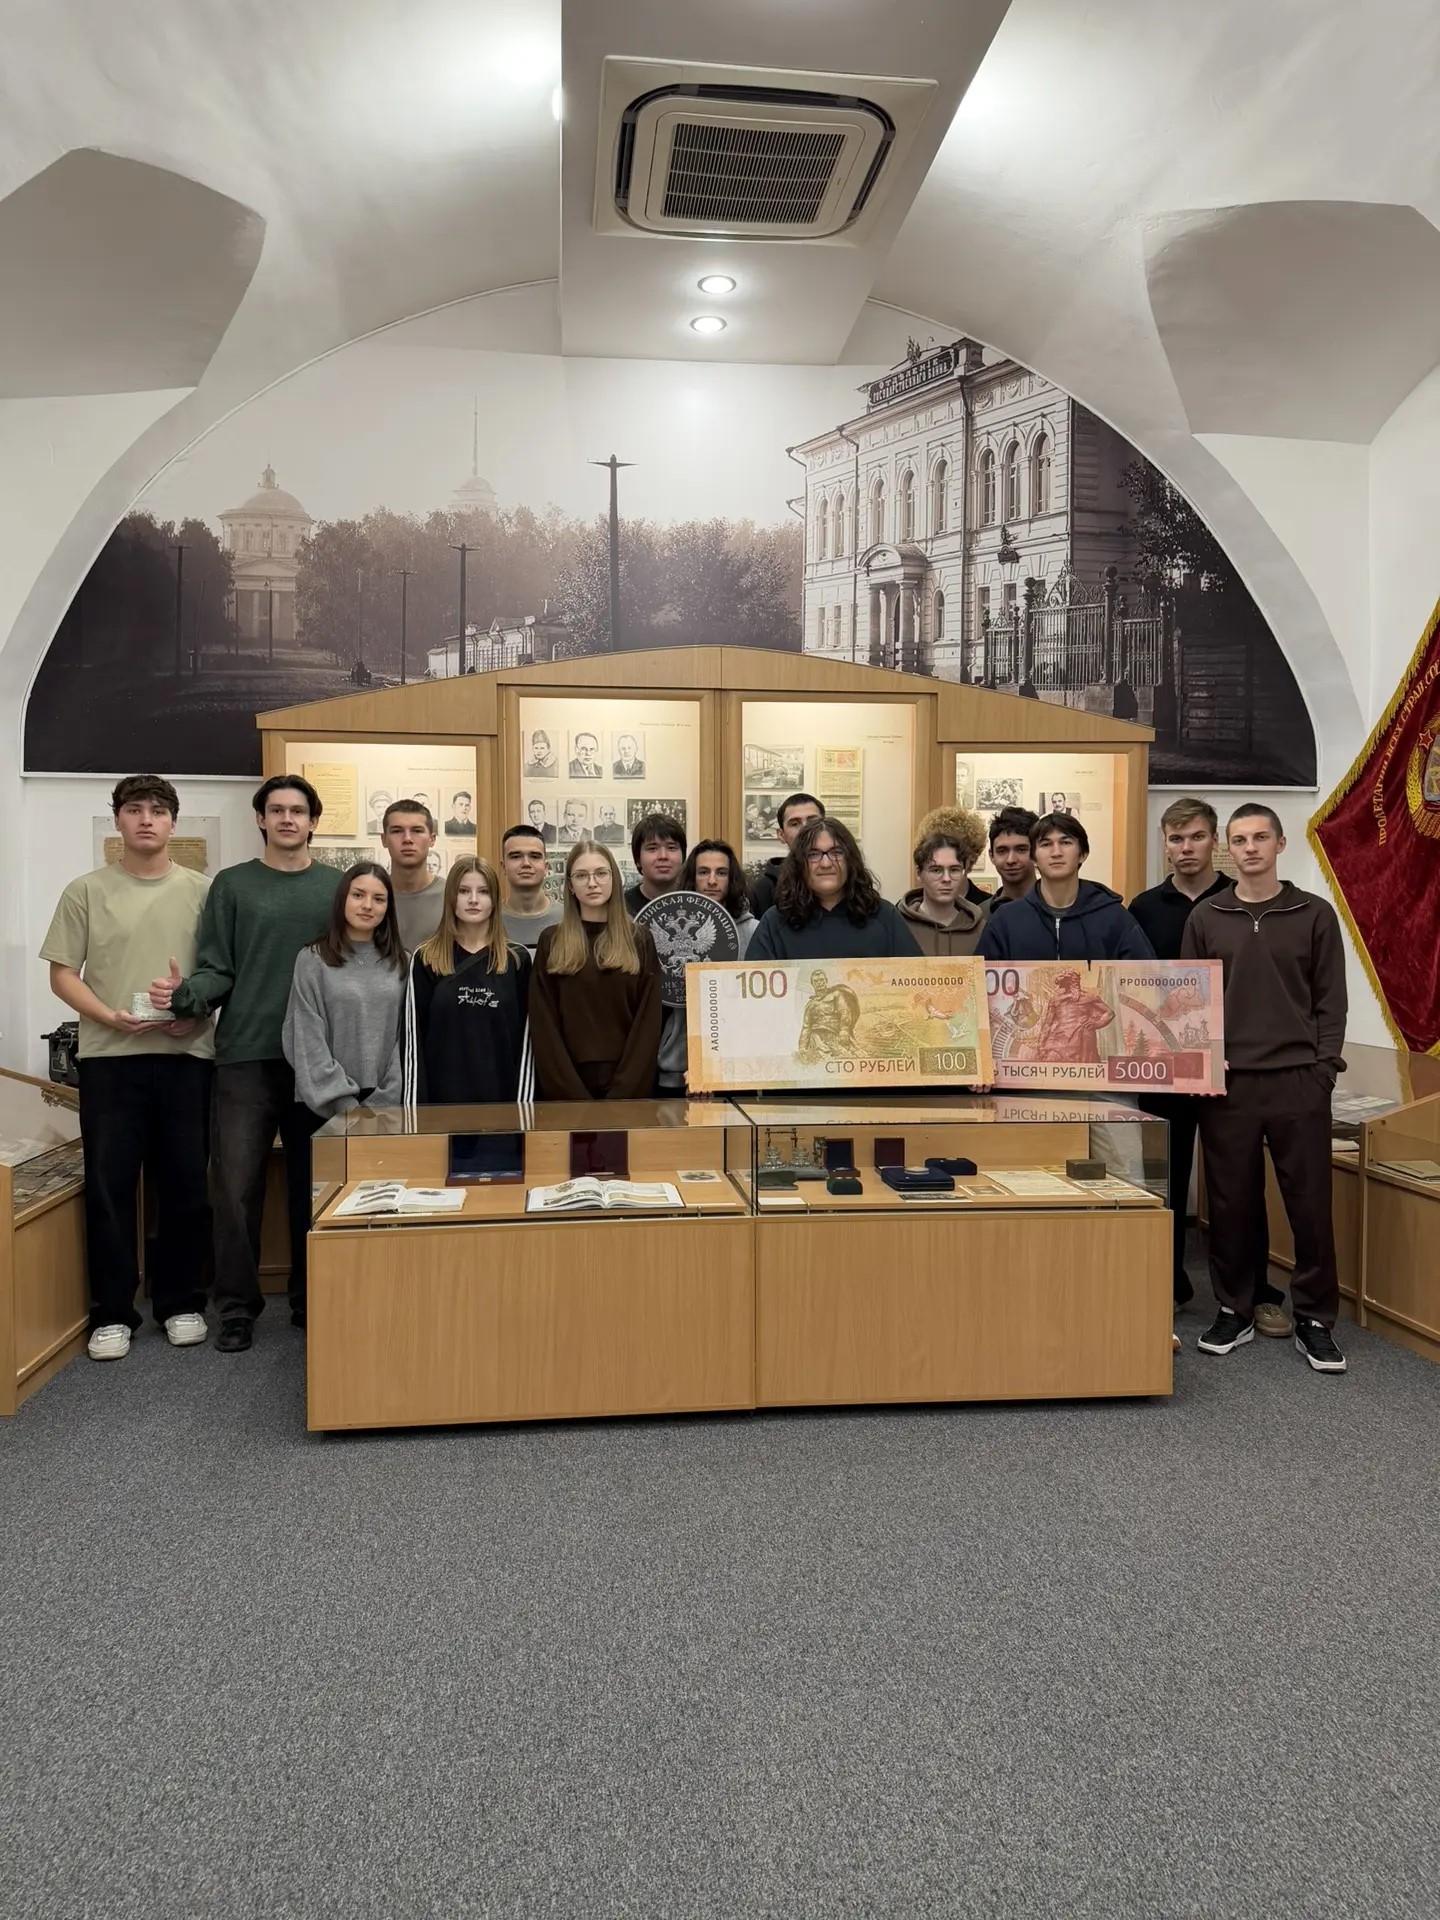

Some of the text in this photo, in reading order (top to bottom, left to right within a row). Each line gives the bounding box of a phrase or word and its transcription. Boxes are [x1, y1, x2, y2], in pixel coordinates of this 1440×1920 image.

[686, 895, 735, 940] ФЕДЕРАЦИЯ
[735, 970, 788, 999] 100
[825, 1056, 916, 1074] СТО РУБЛЕЙ
[934, 1052, 967, 1071] 100
[1002, 1065, 1048, 1077] ТЫСЯЧ
[1052, 1064, 1105, 1078] РУБЛЕЙ
[1114, 1061, 1167, 1080] 5000
